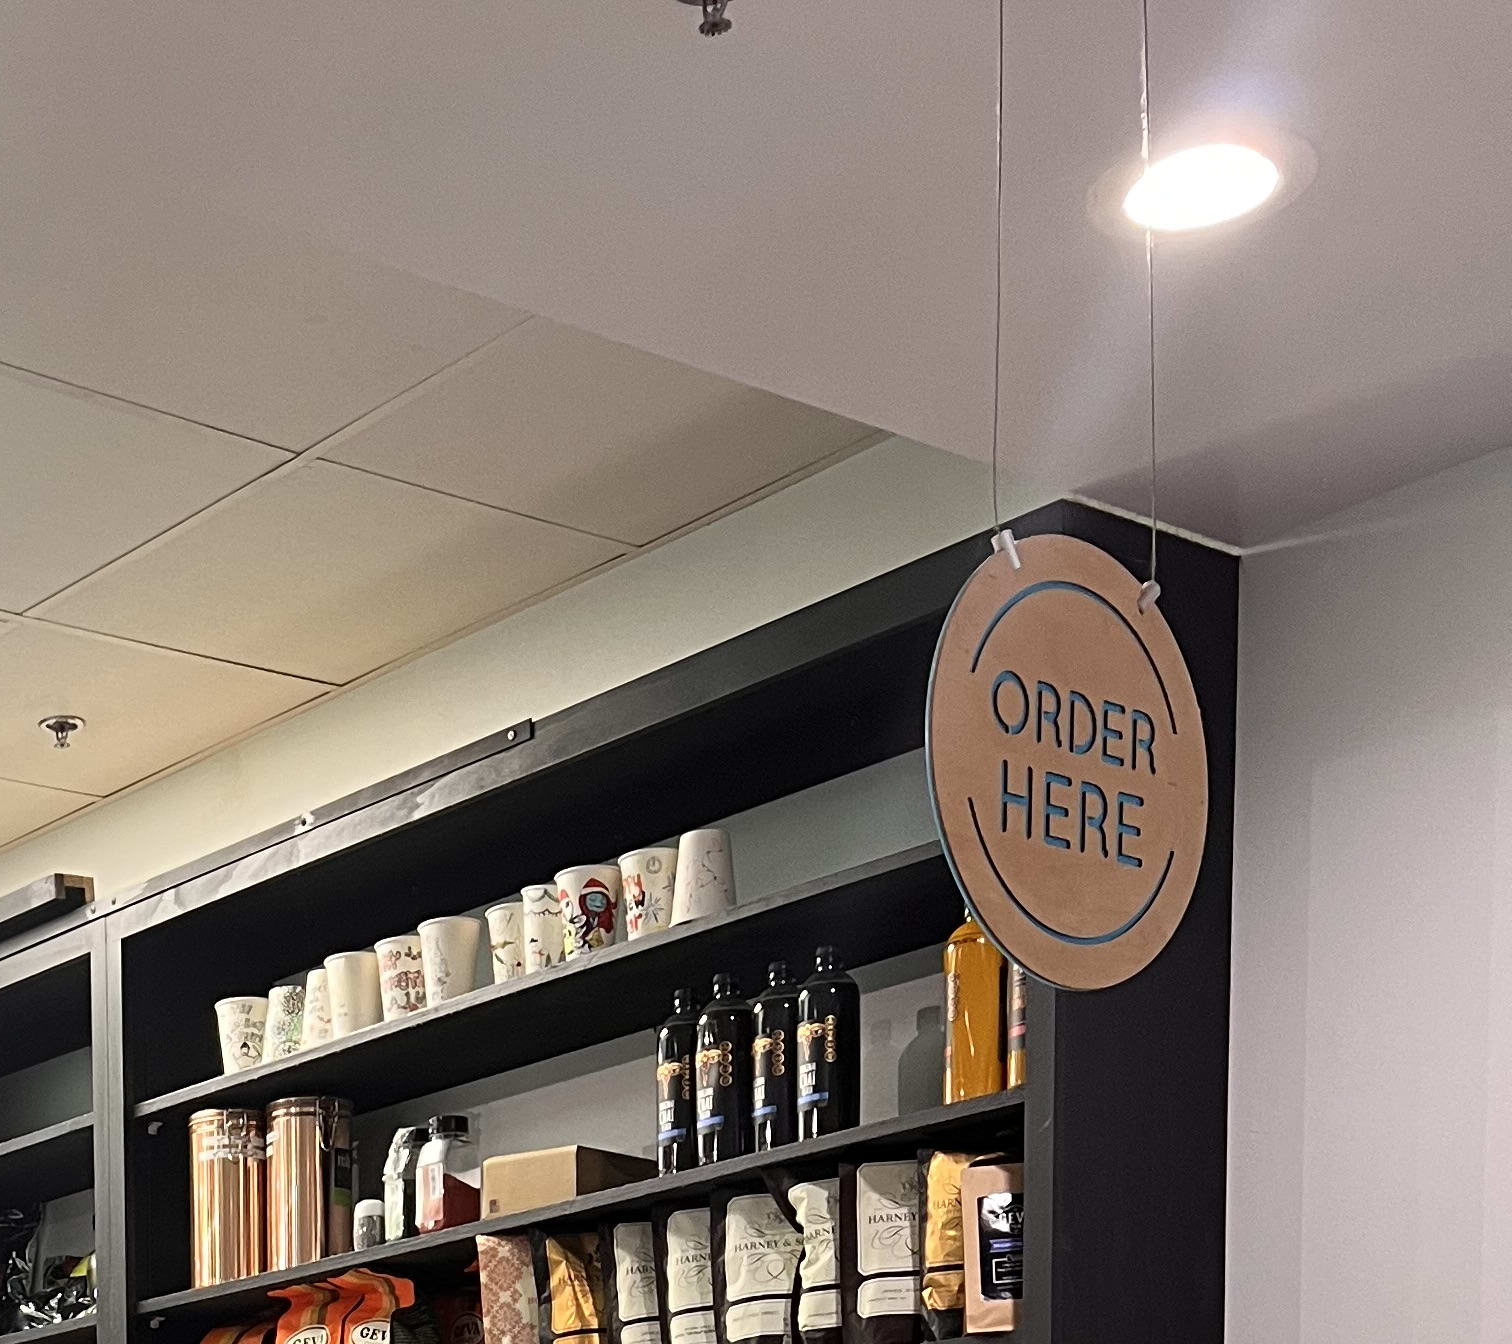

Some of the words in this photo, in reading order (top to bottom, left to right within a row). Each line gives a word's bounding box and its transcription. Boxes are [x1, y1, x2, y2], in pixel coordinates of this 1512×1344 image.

[991, 669, 1157, 775] ORDER
[1000, 759, 1144, 869] HERE
[734, 1240, 778, 1253] HARNEY
[868, 1212, 918, 1224] HARNEY
